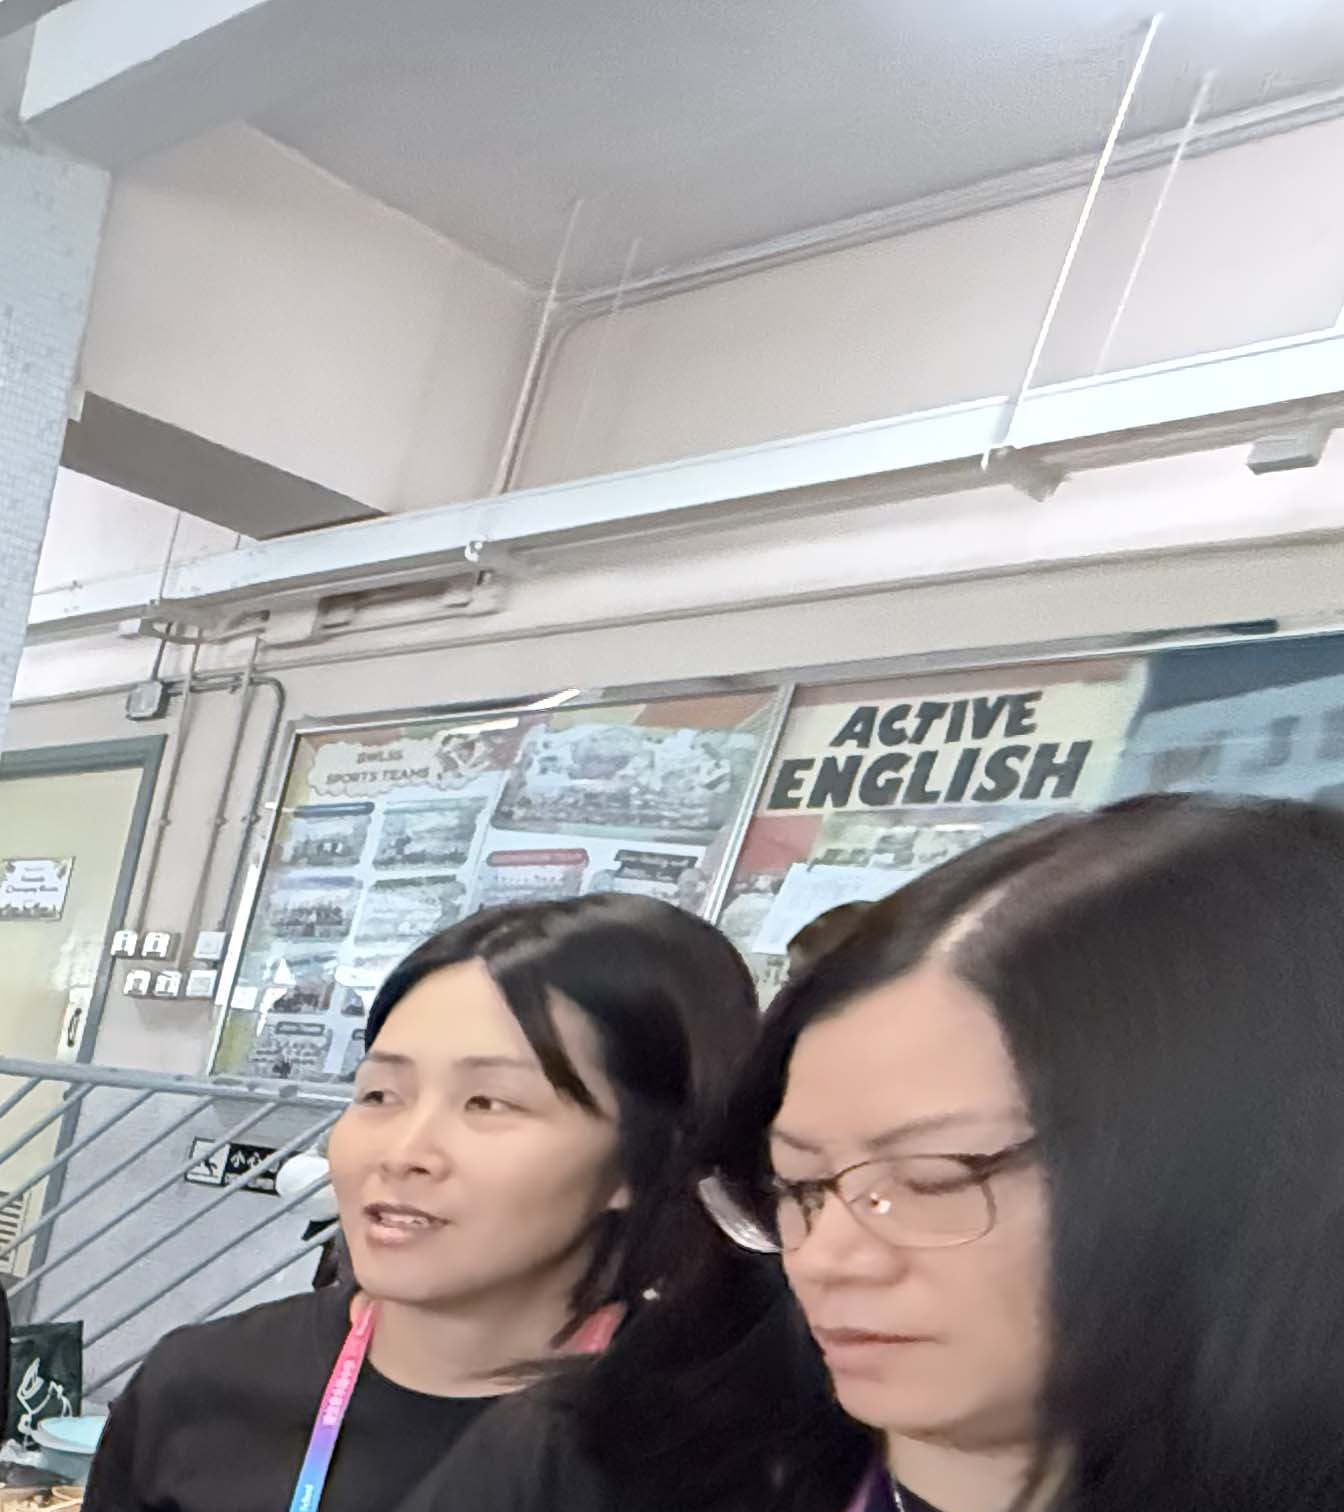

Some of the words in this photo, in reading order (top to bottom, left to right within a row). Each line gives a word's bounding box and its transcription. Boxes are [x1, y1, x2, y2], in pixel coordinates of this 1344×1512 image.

[829, 690, 1043, 748] ACTIVE
[326, 771, 377, 785] SPORTS
[383, 767, 430, 781] TEAMS
[767, 740, 1093, 809] ENGLISH
